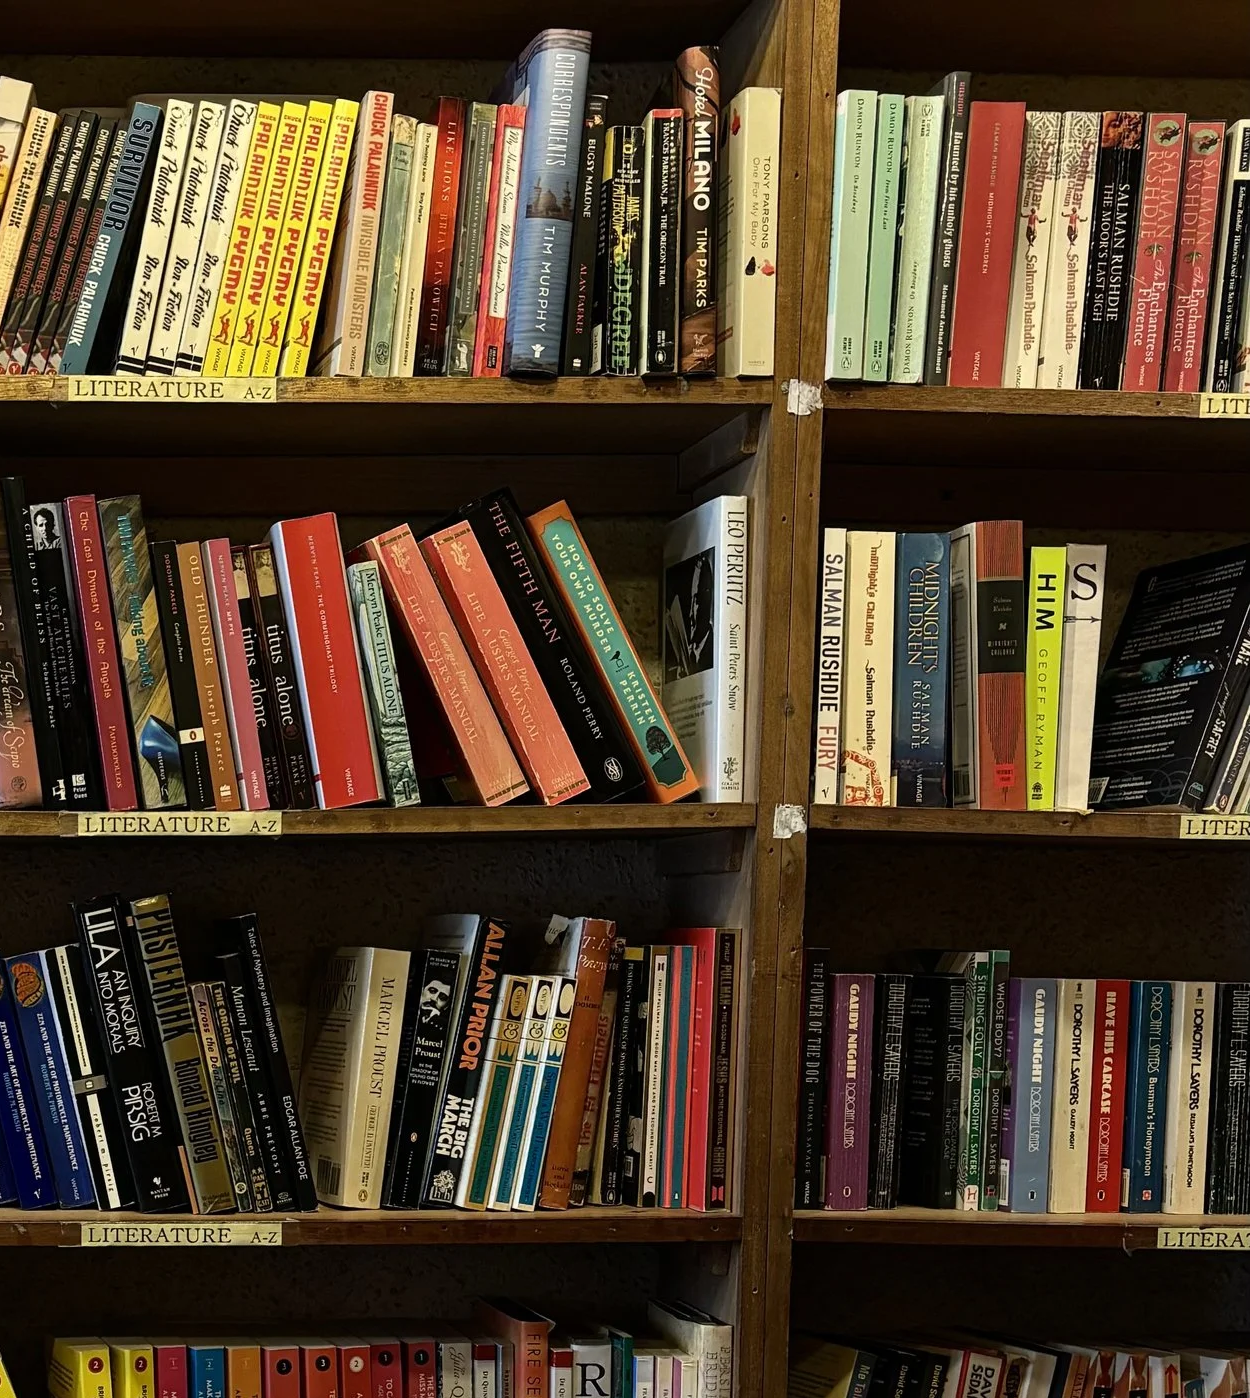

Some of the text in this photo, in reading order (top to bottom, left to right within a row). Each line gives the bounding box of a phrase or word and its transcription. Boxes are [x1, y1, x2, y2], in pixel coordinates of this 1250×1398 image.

[68, 116, 153, 348] SURVIVOR CHUCK PALAHNIUK
[535, 52, 575, 333] CORRESPONDENTS TIM MURPHY
[692, 67, 715, 308] Hotel MILANO TIM PARKS
[1105, 183, 1131, 323] SALMAN RUSHDIE
[75, 381, 272, 400] LITERATURE A-Z
[490, 501, 561, 645] THE FIFTH MAN
[726, 510, 745, 606] LEO PERUTZ
[1071, 563, 1098, 601] S
[817, 553, 843, 771] SALMAN RUSHDIE FURY
[1033, 573, 1057, 771] HIM GEOFF RYMAN
[85, 816, 277, 833] LITERATURE A-Z
[84, 907, 120, 968] LILA
[458, 922, 506, 1070] ALLAN PRIOR
[1030, 988, 1047, 1084] GAUDY NIGHT
[121, 1084, 151, 1144] PIRSIG
[87, 1227, 278, 1244] LITERATURE A-Z
[527, 1333, 542, 1367] FIRE
[576, 1362, 610, 1397] R
